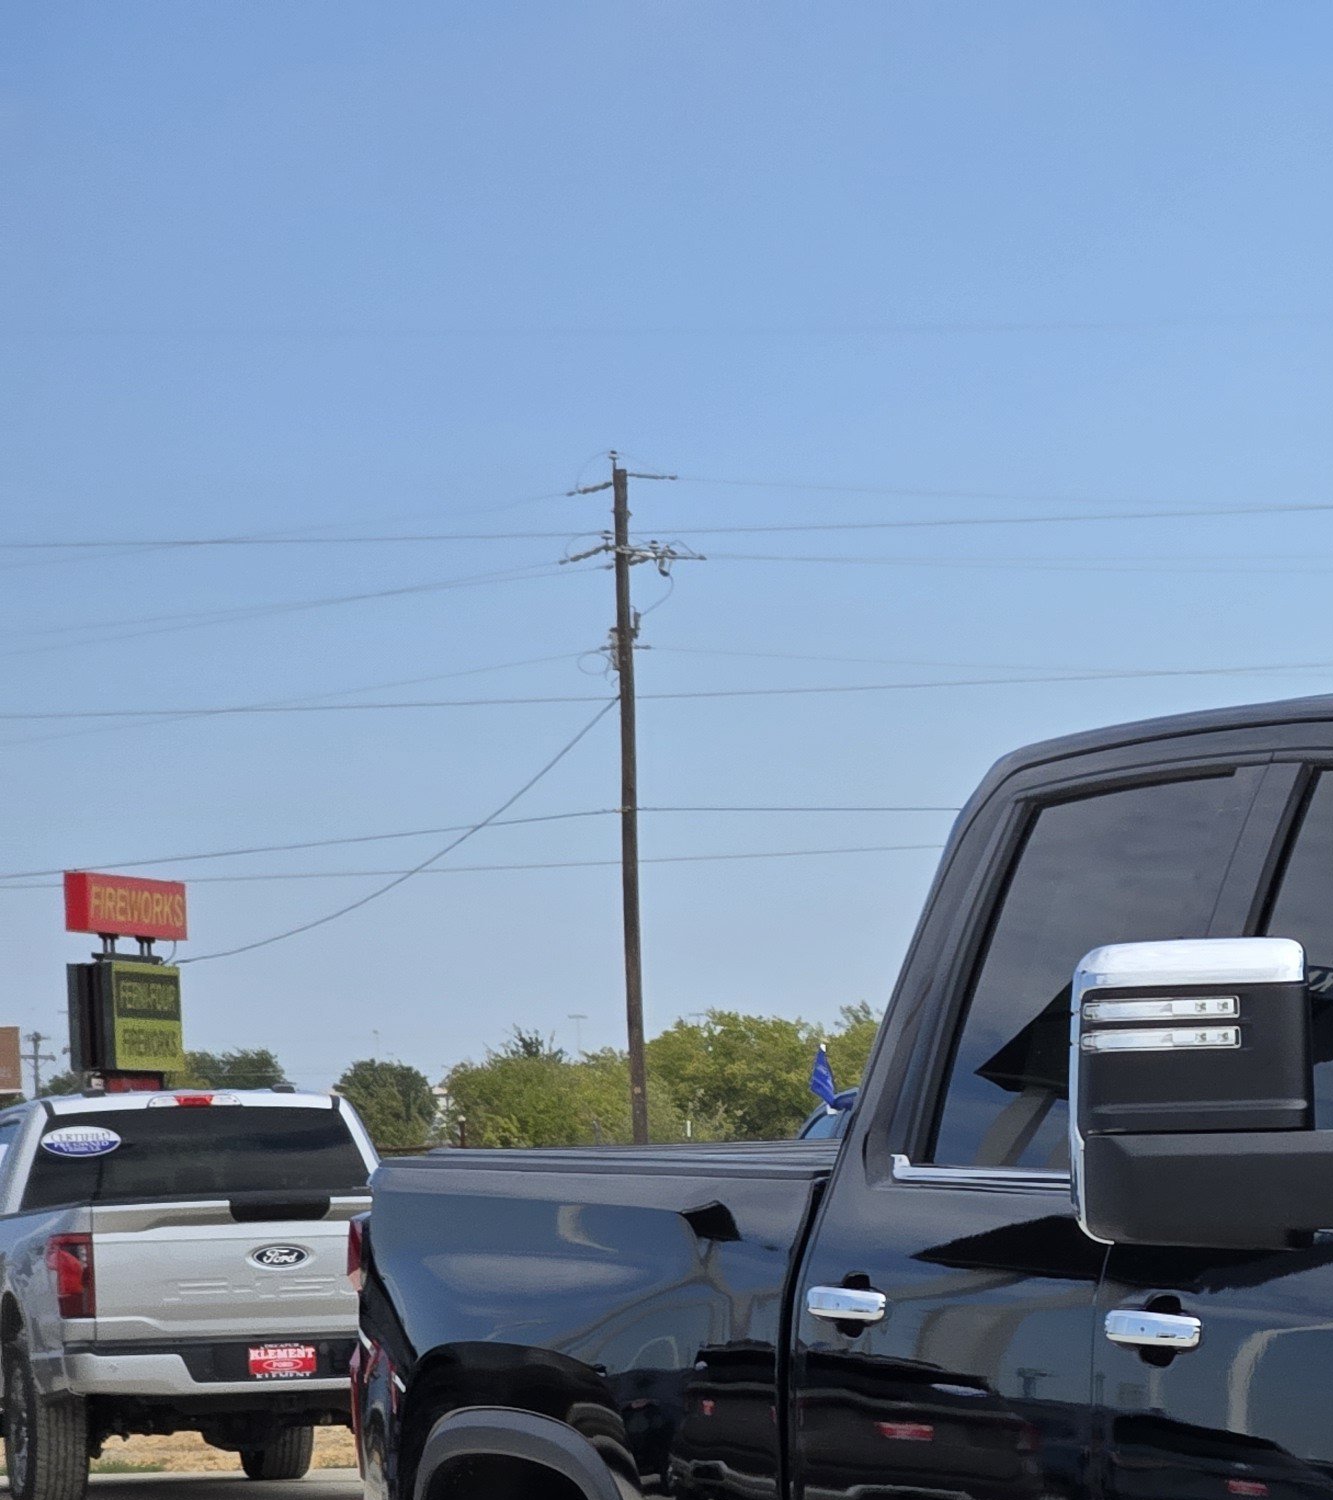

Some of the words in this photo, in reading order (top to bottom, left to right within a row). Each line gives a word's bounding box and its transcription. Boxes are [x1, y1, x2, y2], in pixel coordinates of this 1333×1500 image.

[90, 884, 185, 928] FIREWORKS
[262, 1248, 298, 1264] Ford
[248, 1346, 316, 1361] KLEMENT
